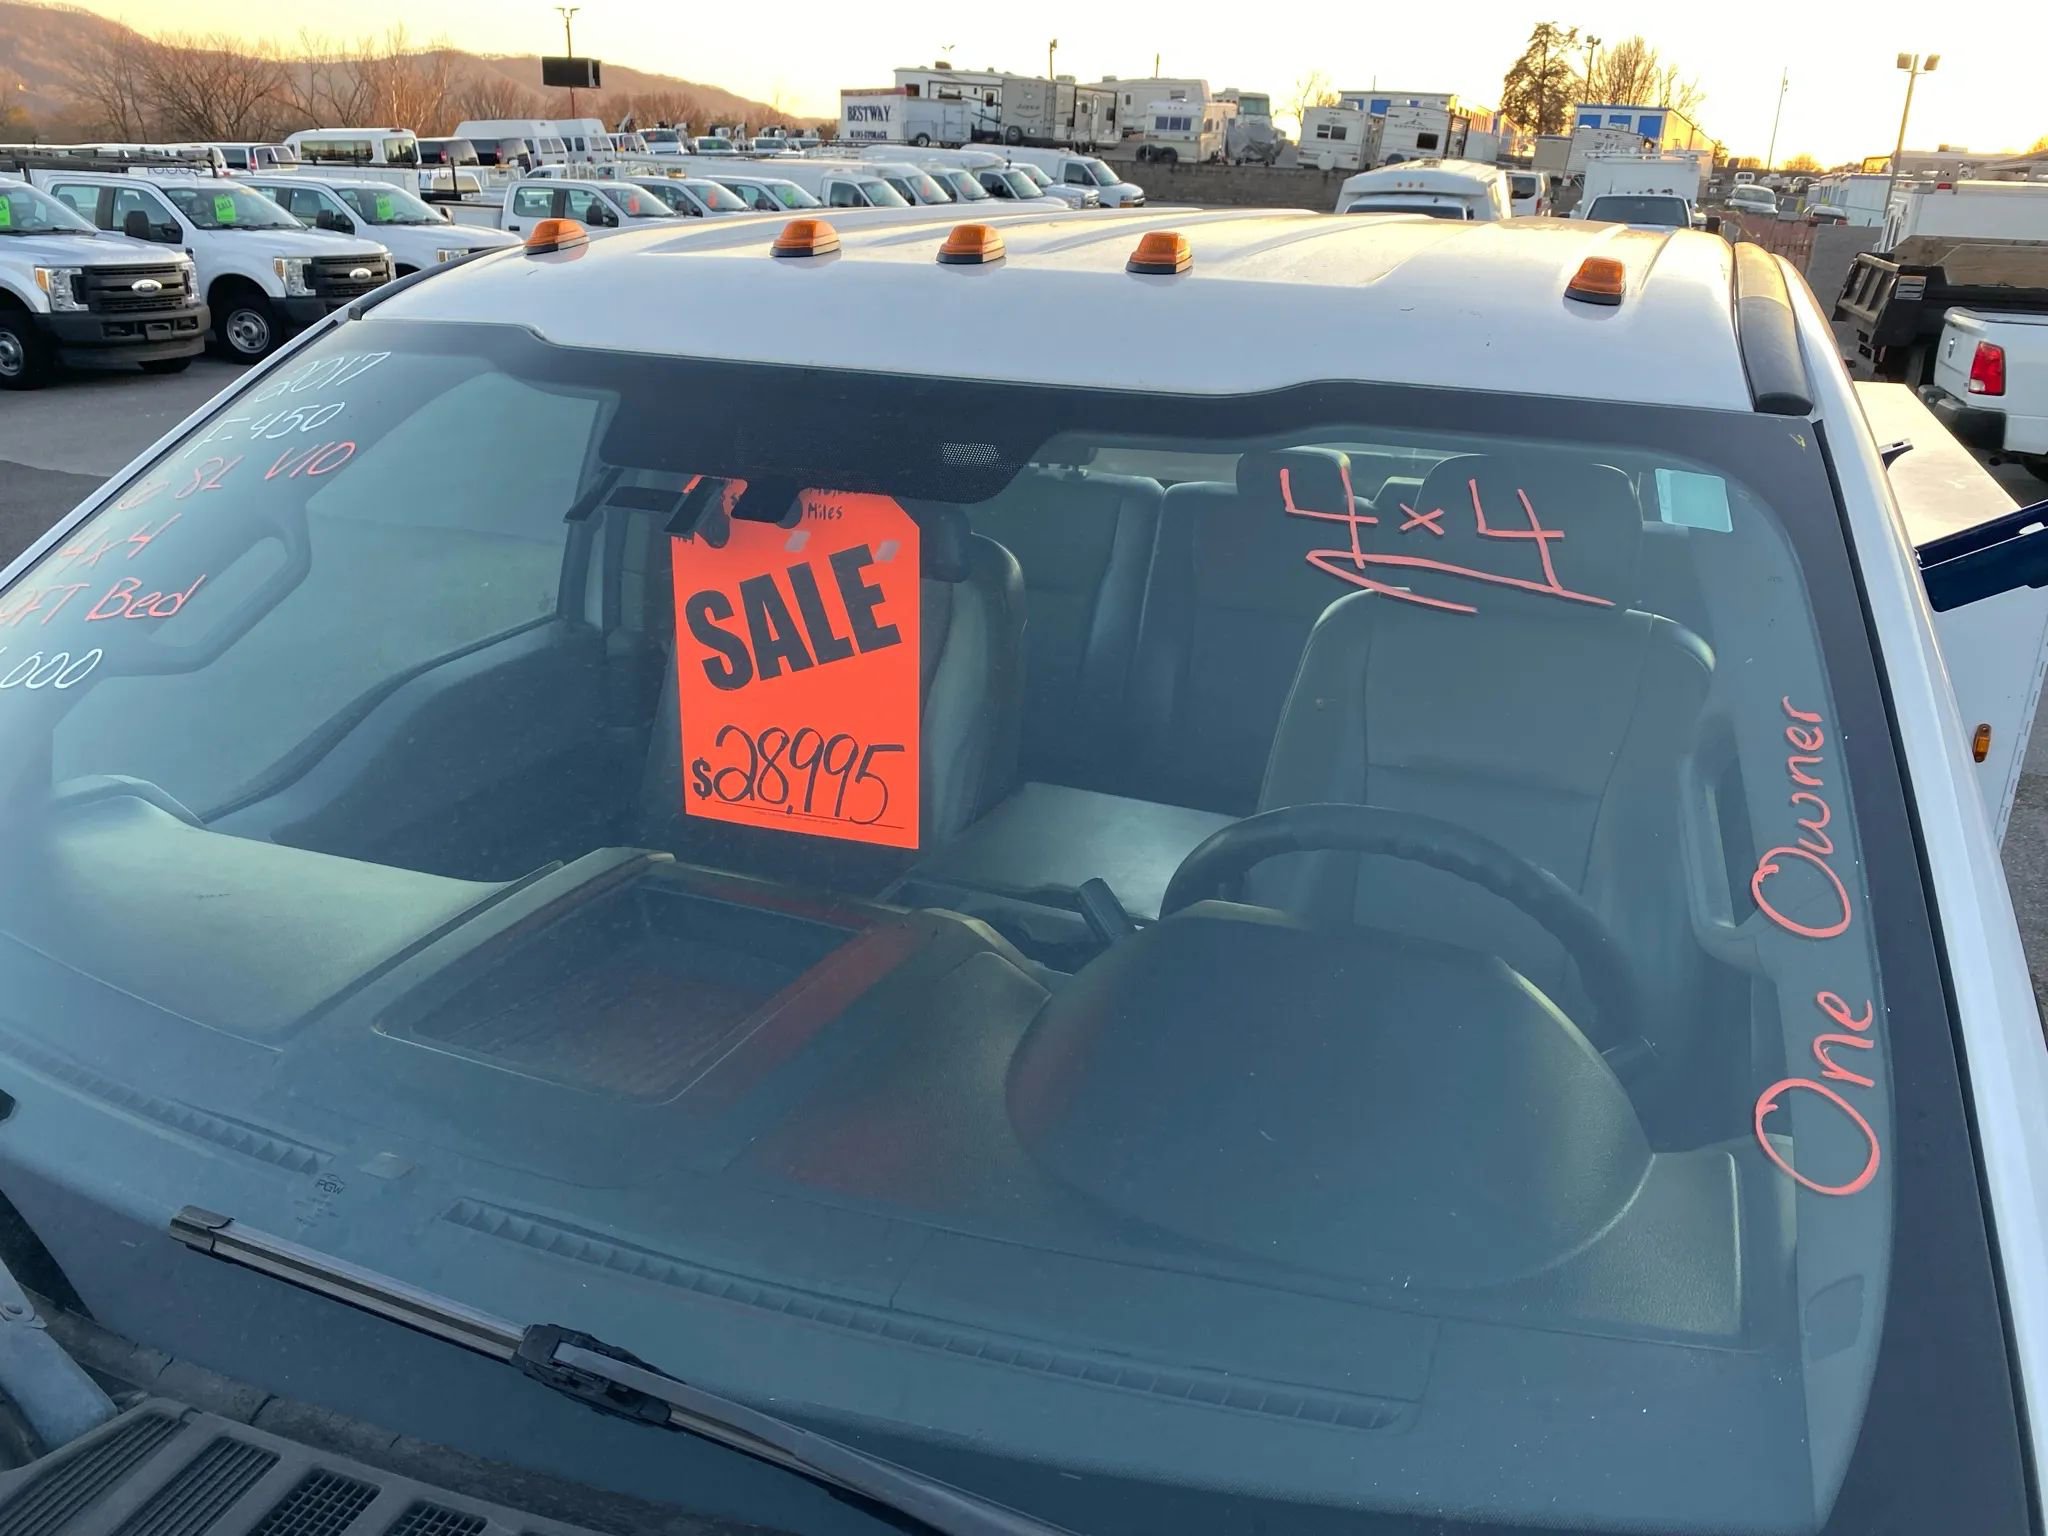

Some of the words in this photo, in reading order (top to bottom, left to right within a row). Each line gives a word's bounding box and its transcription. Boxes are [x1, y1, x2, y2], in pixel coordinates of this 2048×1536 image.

[847, 104, 891, 122] BESTWAY
[255, 351, 392, 403] 2017
[264, 440, 357, 480] V10
[807, 502, 843, 521] Miles
[84, 574, 208, 622] Bed
[685, 543, 903, 692] SALE
[0, 646, 103, 690] 000
[692, 724, 905, 825] $28,995
[1751, 695, 1852, 938] Owner
[1755, 990, 1881, 1196] One
